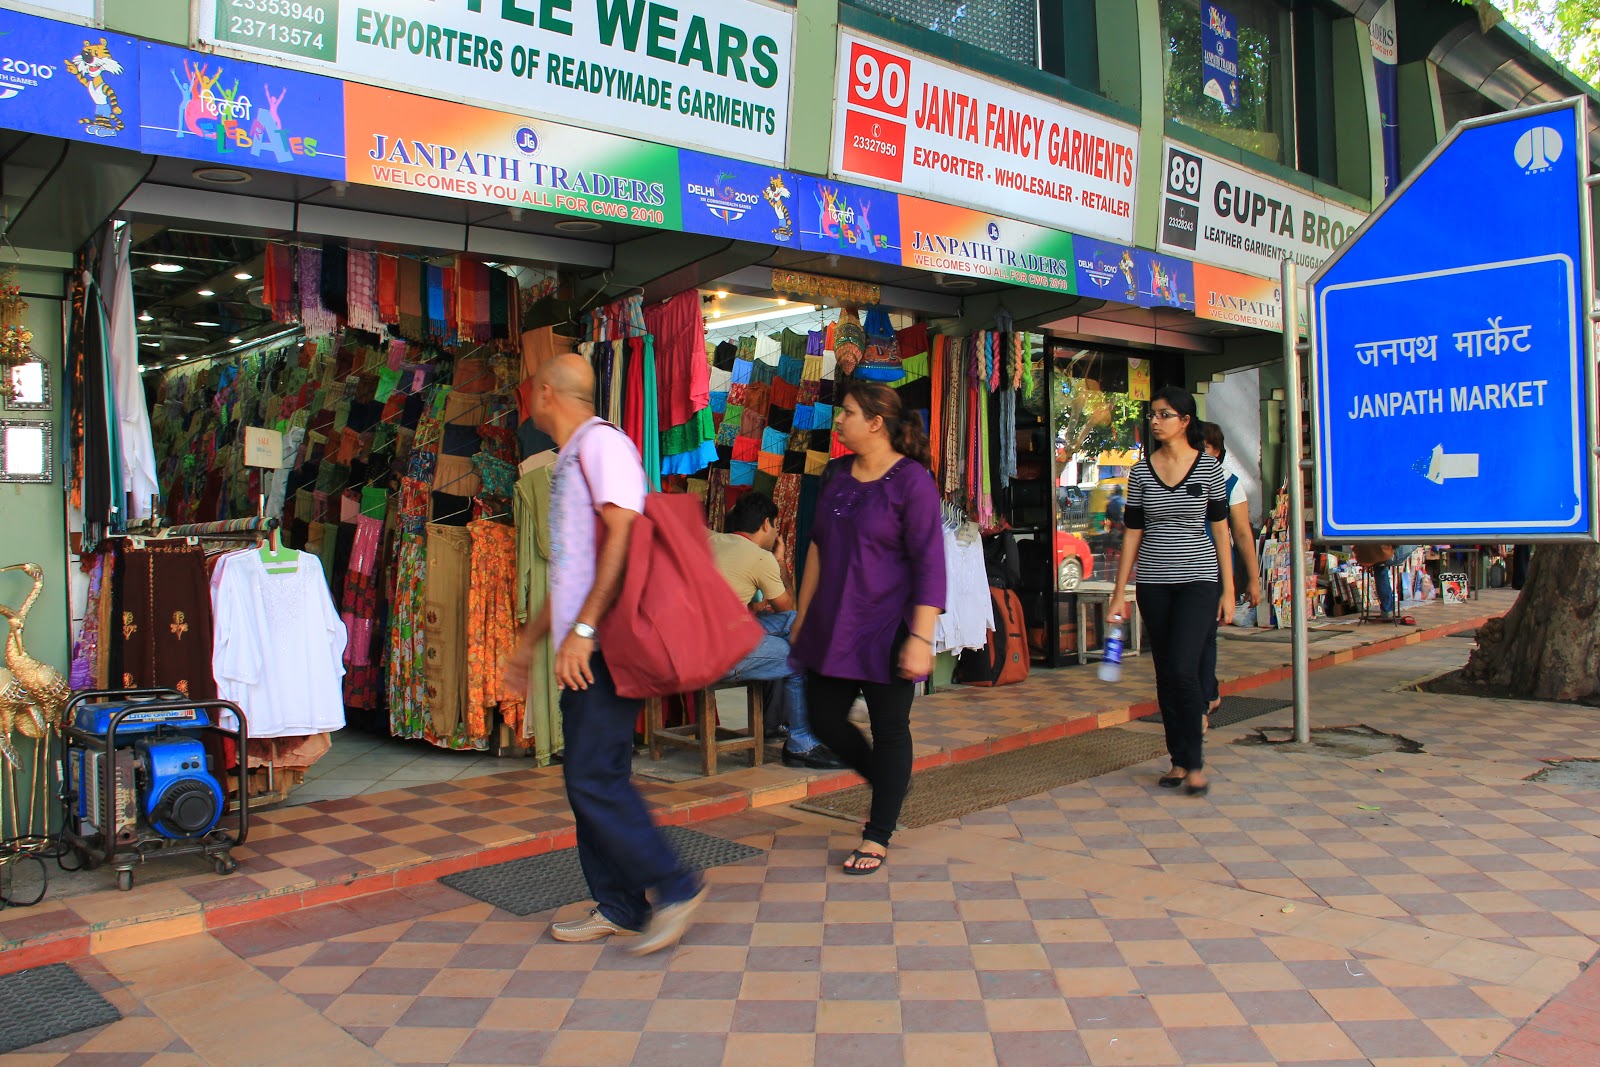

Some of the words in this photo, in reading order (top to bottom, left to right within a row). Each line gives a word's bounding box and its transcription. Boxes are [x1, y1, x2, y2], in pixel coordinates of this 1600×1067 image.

[231, 15, 325, 50] 23713574
[596, 0, 779, 89] WEARS
[10, 75, 39, 87] GAMES
[356, 7, 504, 73] EXPORTERS
[510, 45, 541, 80] OF
[546, 53, 672, 111] READYMADE
[677, 85, 777, 136] GARMENTS
[854, 53, 906, 108] 90
[852, 134, 898, 157] 23327950
[914, 82, 979, 144] JANTA
[984, 102, 1045, 160] FANCY
[1048, 122, 1134, 187] GARMENTS
[369, 134, 521, 182] JANPATH
[529, 161, 666, 206] TRADERS
[687, 183, 715, 197] DELHI
[912, 146, 984, 181] EXPORTER
[995, 167, 1073, 203] WHOLESALER
[1081, 190, 1131, 218] RETAILER
[1169, 155, 1200, 195] 89
[372, 165, 478, 195] WELCOMES
[482, 183, 518, 201] YOU
[521, 190, 553, 207] ALL
[556, 195, 589, 213] FOR
[592, 200, 628, 219] CWG
[631, 206, 664, 224] 2010
[1213, 180, 1295, 240] GUPTA
[912, 230, 993, 262] JANPATH
[996, 247, 1068, 277] TRADERS
[1204, 225, 1242, 249] LEATHER
[1244, 236, 1287, 261] GARMENTS
[914, 254, 971, 272] WELCOMES
[973, 264, 992, 276] YOU
[993, 268, 1009, 280] ALL
[1010, 271, 1028, 284] FOR
[1029, 274, 1049, 288] CWG
[1049, 279, 1068, 290] 2010
[1208, 291, 1276, 318] JANPATH
[1209, 308, 1258, 325] WELCOMES
[1259, 319, 1275, 329] YOU
[1354, 335, 1438, 367] जनपथ
[1452, 315, 1532, 358] मार्केट
[1348, 388, 1443, 420] JANPATH
[1450, 379, 1548, 412] MARKET
